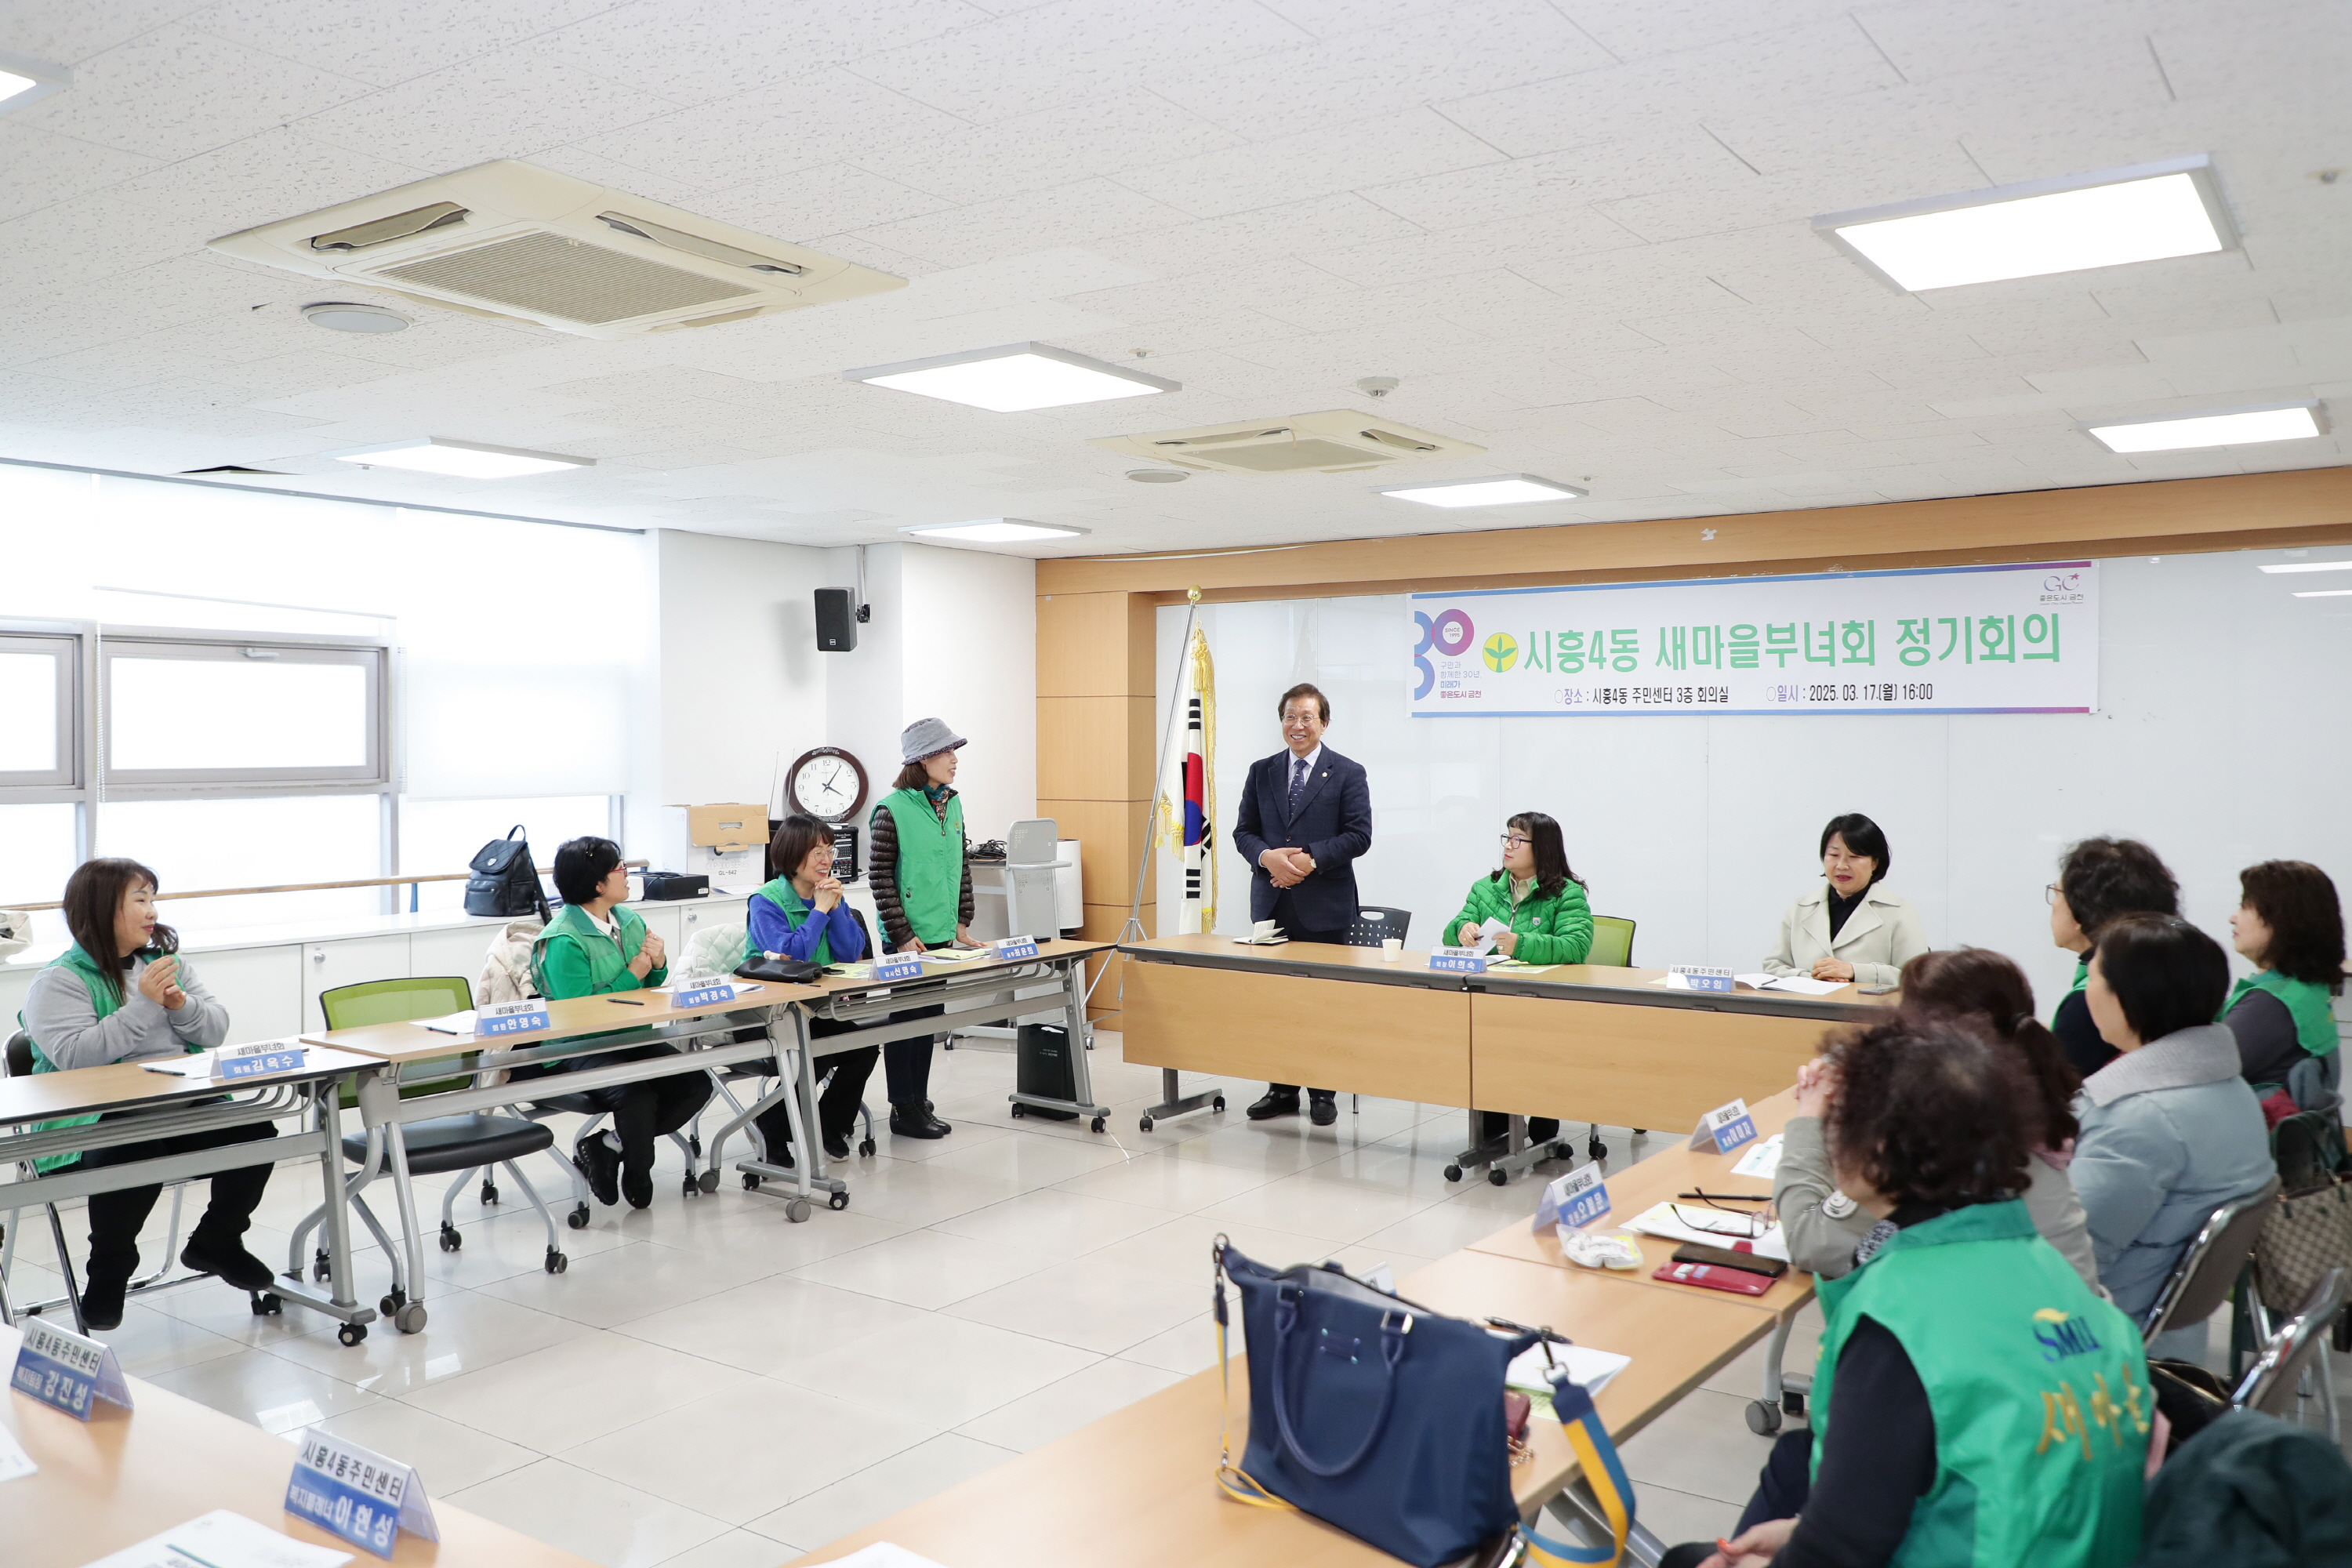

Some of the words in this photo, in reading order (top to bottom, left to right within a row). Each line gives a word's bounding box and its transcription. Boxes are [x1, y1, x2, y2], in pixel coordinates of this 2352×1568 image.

[1523, 628, 1640, 673] 시흥4동
[1655, 619, 1875, 670] 새마을부녀회
[1896, 612, 2060, 667] 정기회의
[1440, 661, 1461, 670] 구민과
[1440, 670, 1461, 679] 함께한
[1440, 690, 1468, 699] 좋은도시
[1468, 690, 1482, 699] 금천
[1592, 688, 1628, 705] 시흥4동
[1632, 686, 1673, 704] 주민센터
[1676, 686, 1693, 703] 3층
[1697, 685, 1730, 704] 회의실
[1809, 684, 1838, 702] 2025.
[1842, 684, 1859, 702] 03.
[1902, 683, 1933, 700] 16:00
[885, 956, 911, 964] 새마을부녀회
[1448, 959, 1475, 970] 이희숙
[1671, 967, 1730, 976] 시흥4동주민센터
[690, 978, 721, 989] 새마을부녀회
[1690, 978, 1722, 989] 박오임
[700, 989, 728, 1002] 박경숙
[495, 1004, 534, 1015] 새마을부녀회
[492, 1023, 506, 1032] 회원
[507, 1015, 541, 1030] 안영숙
[238, 1043, 285, 1056] 새마을부녀회
[234, 1065, 251, 1074] 회원
[252, 1055, 294, 1072] 김옥수
[27, 1327, 102, 1374] 시흥4동주민센터
[44, 1370, 89, 1411] 강진성
[302, 1439, 404, 1501] 시흥4동주민센터
[335, 1495, 394, 1548] 이현성
